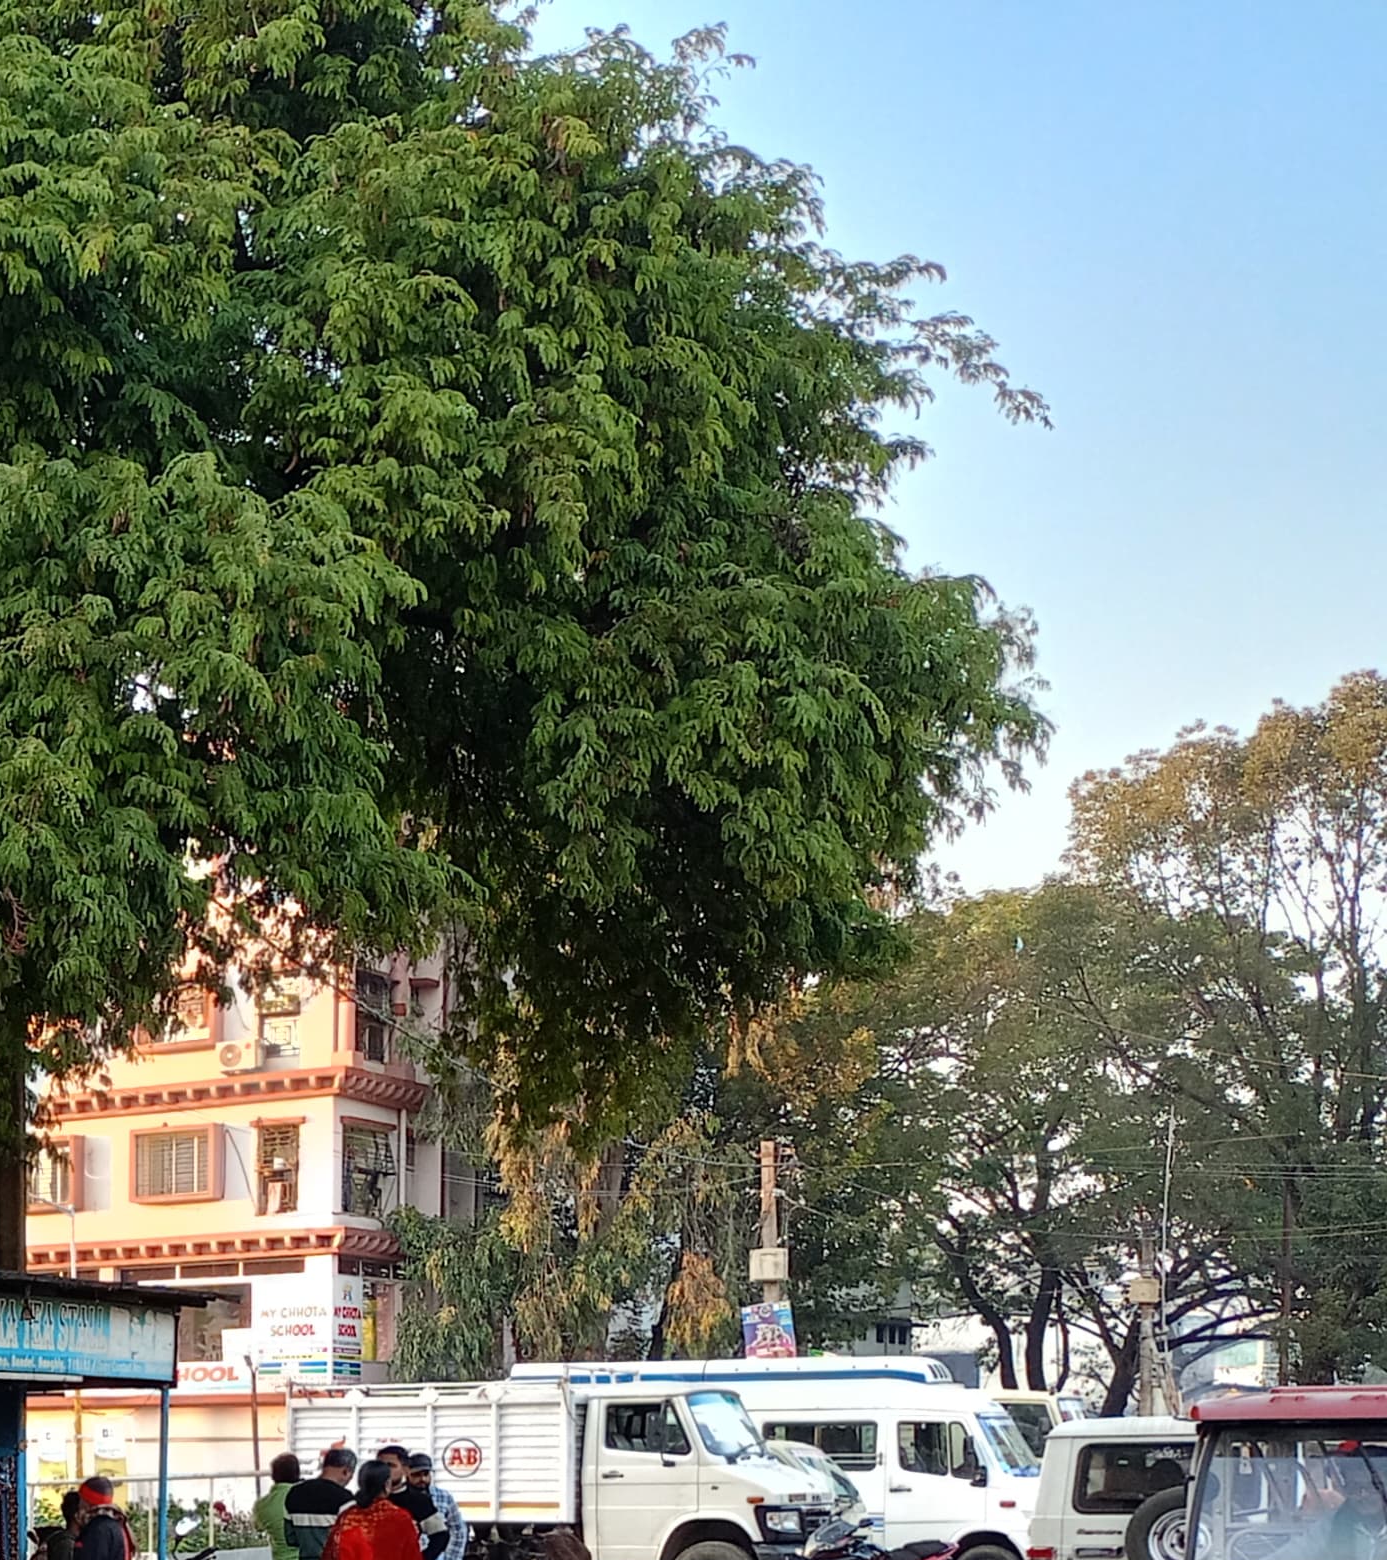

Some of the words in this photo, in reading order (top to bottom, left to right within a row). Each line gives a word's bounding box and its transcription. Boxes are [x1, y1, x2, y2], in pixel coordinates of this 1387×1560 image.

[260, 1307, 277, 1319] MY
[280, 1305, 328, 1319] CHHOTA
[57, 1302, 109, 1352] STALL
[270, 1323, 316, 1337] SCHOOL
[175, 1365, 239, 1383] HOOL
